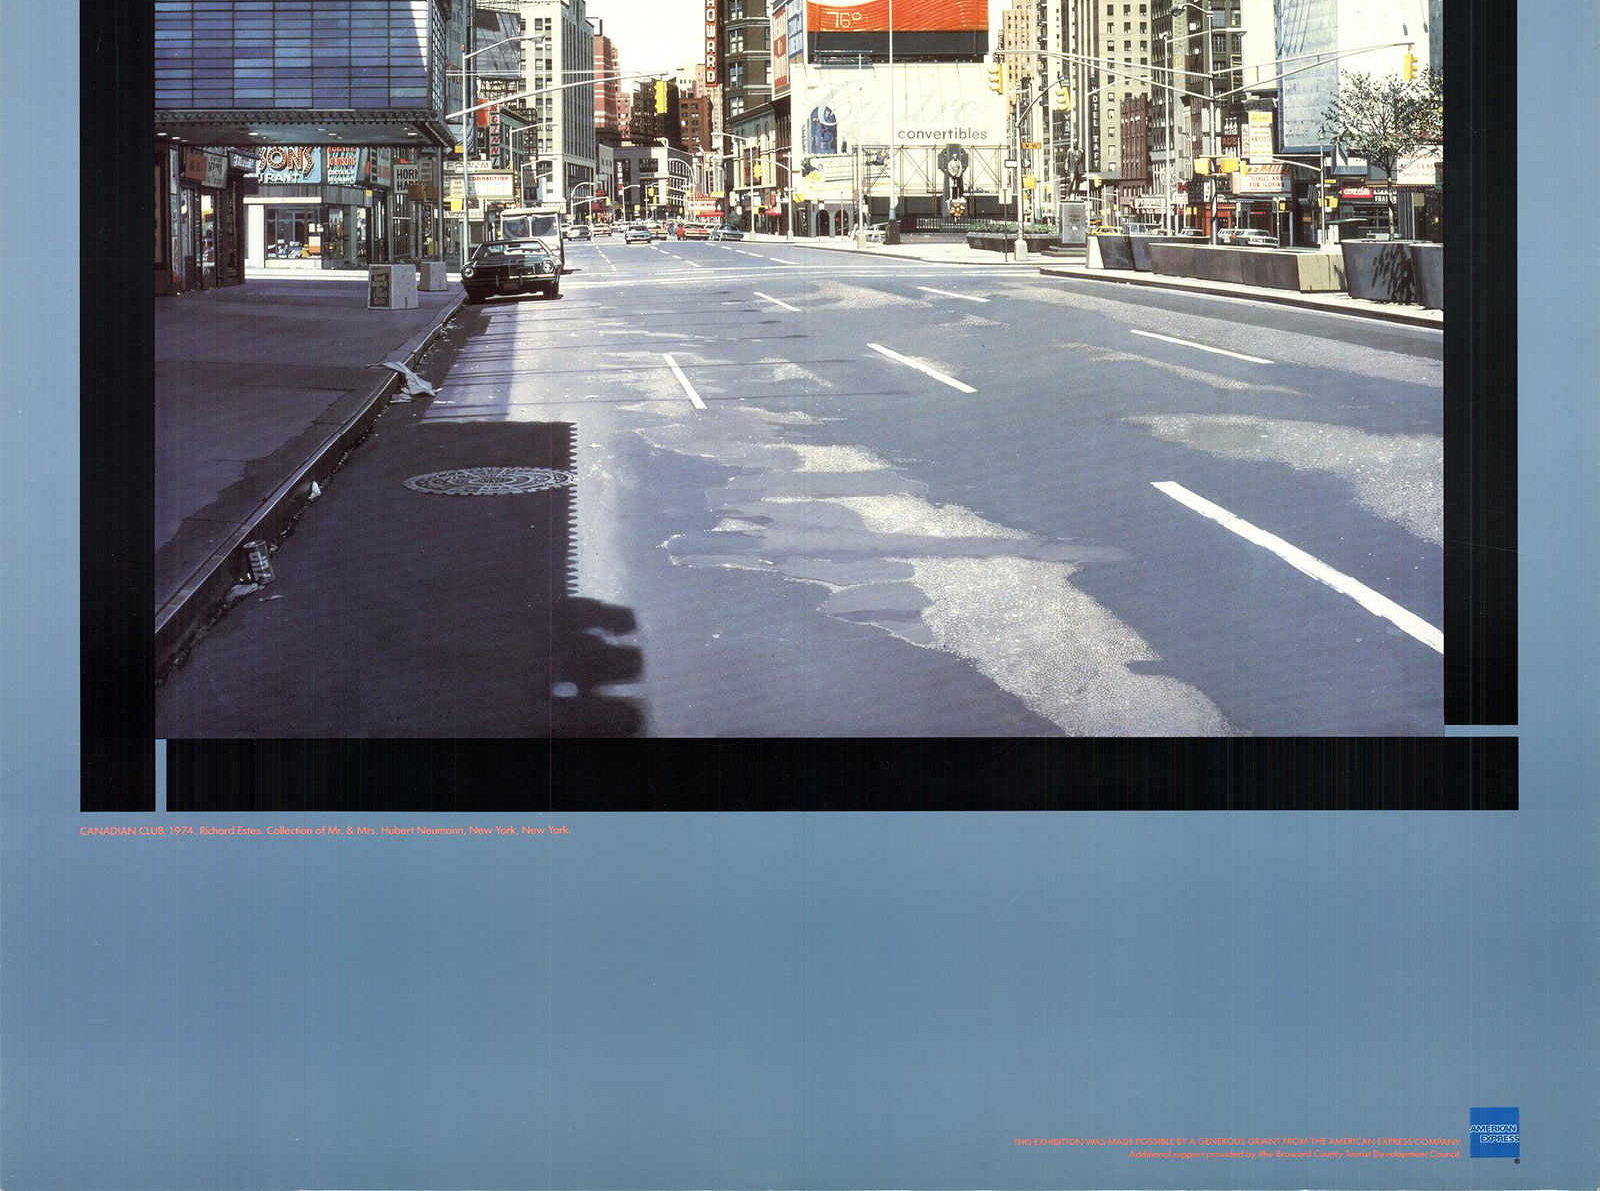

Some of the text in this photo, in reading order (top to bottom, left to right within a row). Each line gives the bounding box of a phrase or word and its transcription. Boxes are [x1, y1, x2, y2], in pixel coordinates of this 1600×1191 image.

[897, 127, 988, 140] convertibles
[80, 825, 572, 836] CANADIAN CLUB, 1974. Richard Estes. Collection of Mr. & Mrs. Hubert Neumann, New York, New York.
[1470, 1124, 1518, 1134] AMERICAN
[1013, 1137, 1032, 1146] THIS
[1033, 1137, 1083, 1146] EXHIBITION
[1085, 1137, 1107, 1146] WAS
[1108, 1137, 1134, 1146] MADE
[1136, 1137, 1175, 1146] POSSIBLE
[1176, 1137, 1188, 1146] BY
[1189, 1137, 1197, 1146] A
[1198, 1137, 1246, 1146] GENEROUS
[1248, 1137, 1281, 1146] GRANT
[1283, 1137, 1309, 1146] FROM
[1311, 1137, 1327, 1146] THE
[1328, 1137, 1375, 1146] AMERICAN
[1377, 1137, 1413, 1146] EXPRESS
[1480, 1134, 1521, 1144] EXPRESS
[1130, 1150, 1171, 1159] Additional
[1172, 1150, 1205, 1161] support
[1206, 1150, 1244, 1161] provided
[1245, 1150, 1256, 1161] by
[1275, 1150, 1312, 1159] Broward
[1313, 1150, 1344, 1161] County
[1345, 1150, 1372, 1159] Tourist
[1373, 1150, 1429, 1161] Development
